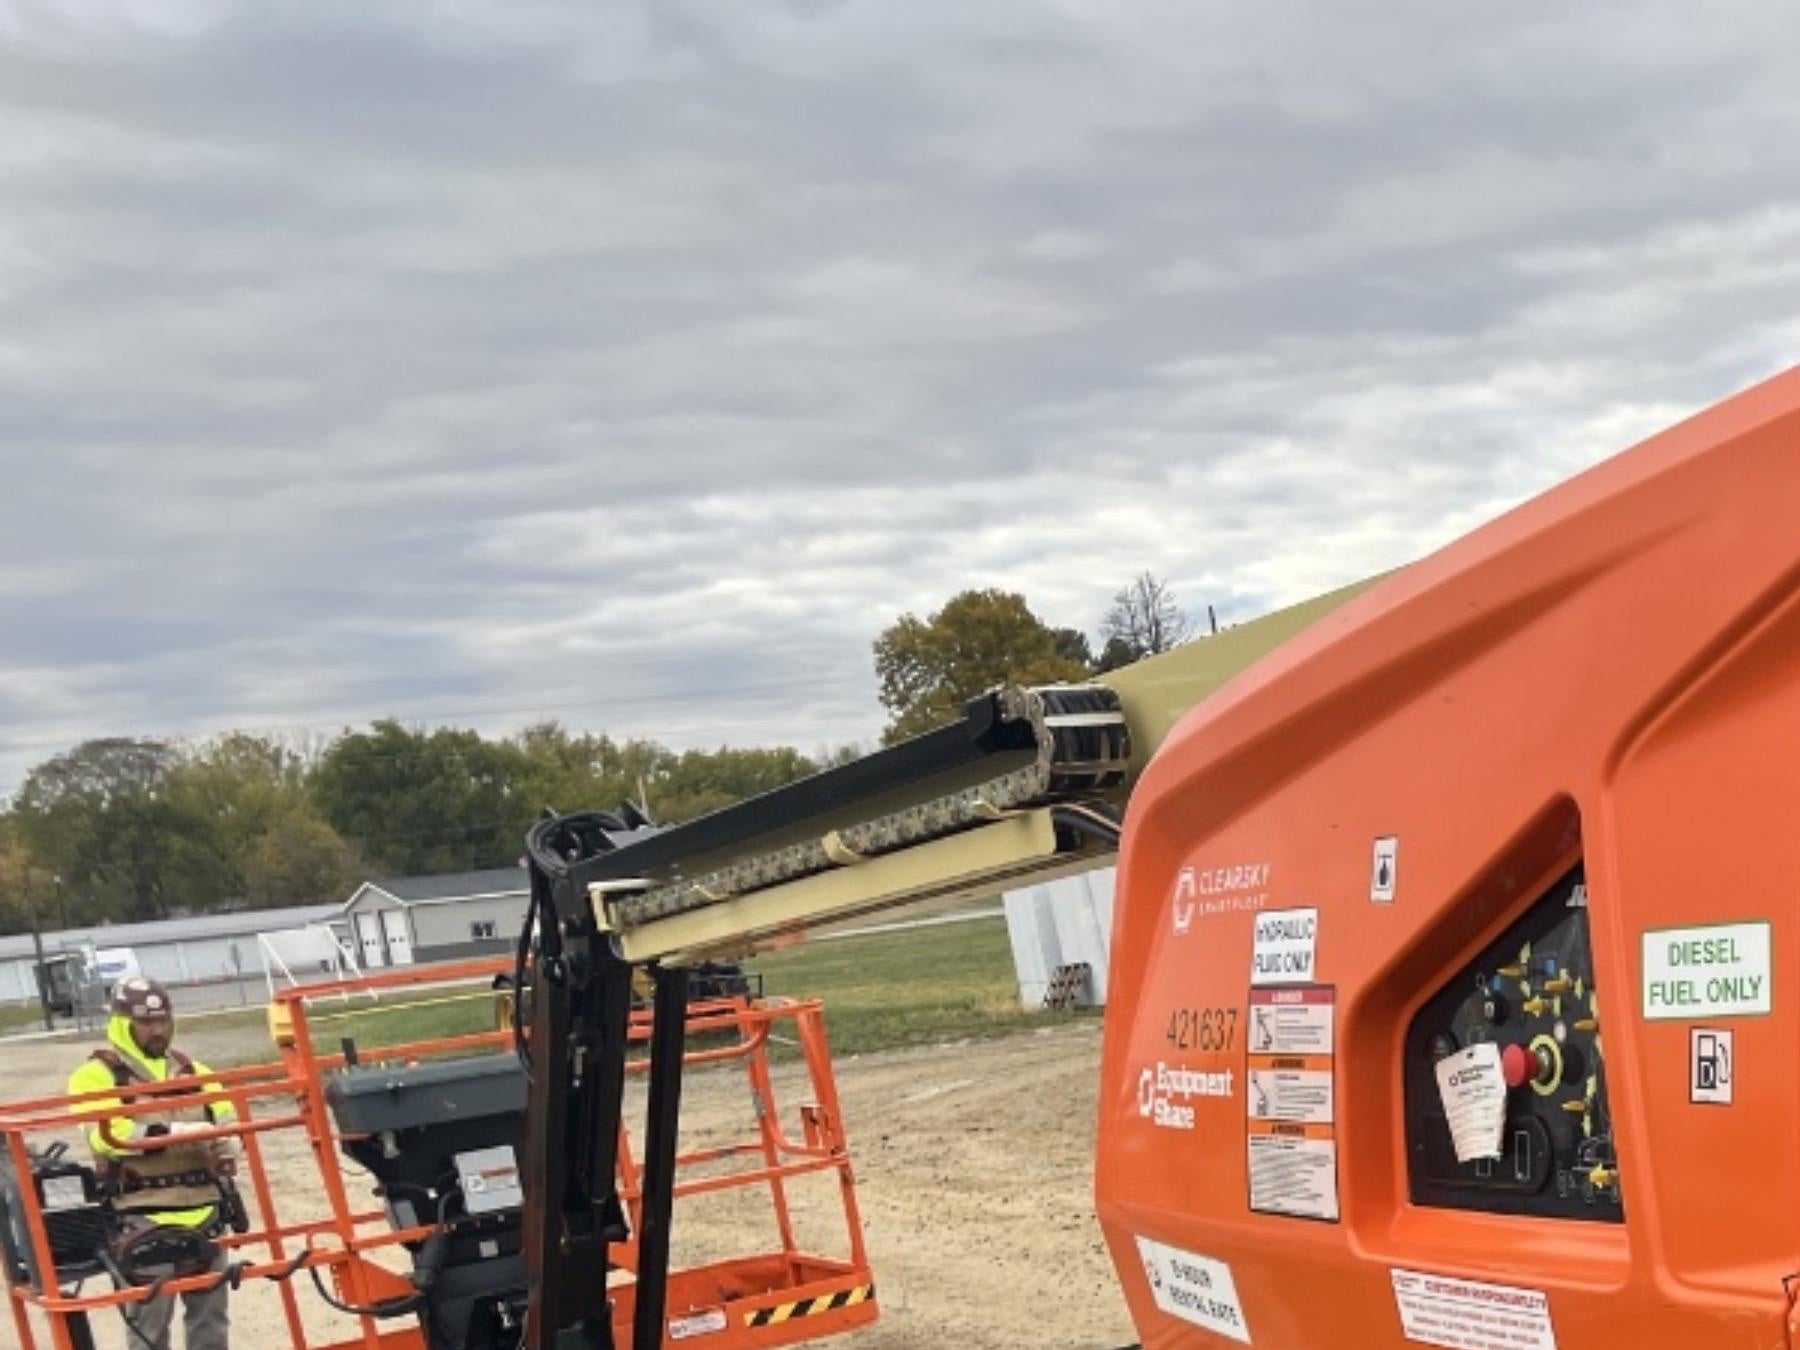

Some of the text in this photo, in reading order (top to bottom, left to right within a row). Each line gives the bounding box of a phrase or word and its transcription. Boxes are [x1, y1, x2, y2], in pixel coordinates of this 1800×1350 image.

[1667, 938, 1741, 967] DIESEL
[1649, 974, 1763, 1006] FUEL ONLY
[1166, 1007, 1238, 1051] 421637
[1157, 1060, 1234, 1101] Equipment
[1153, 1096, 1196, 1129] Share
